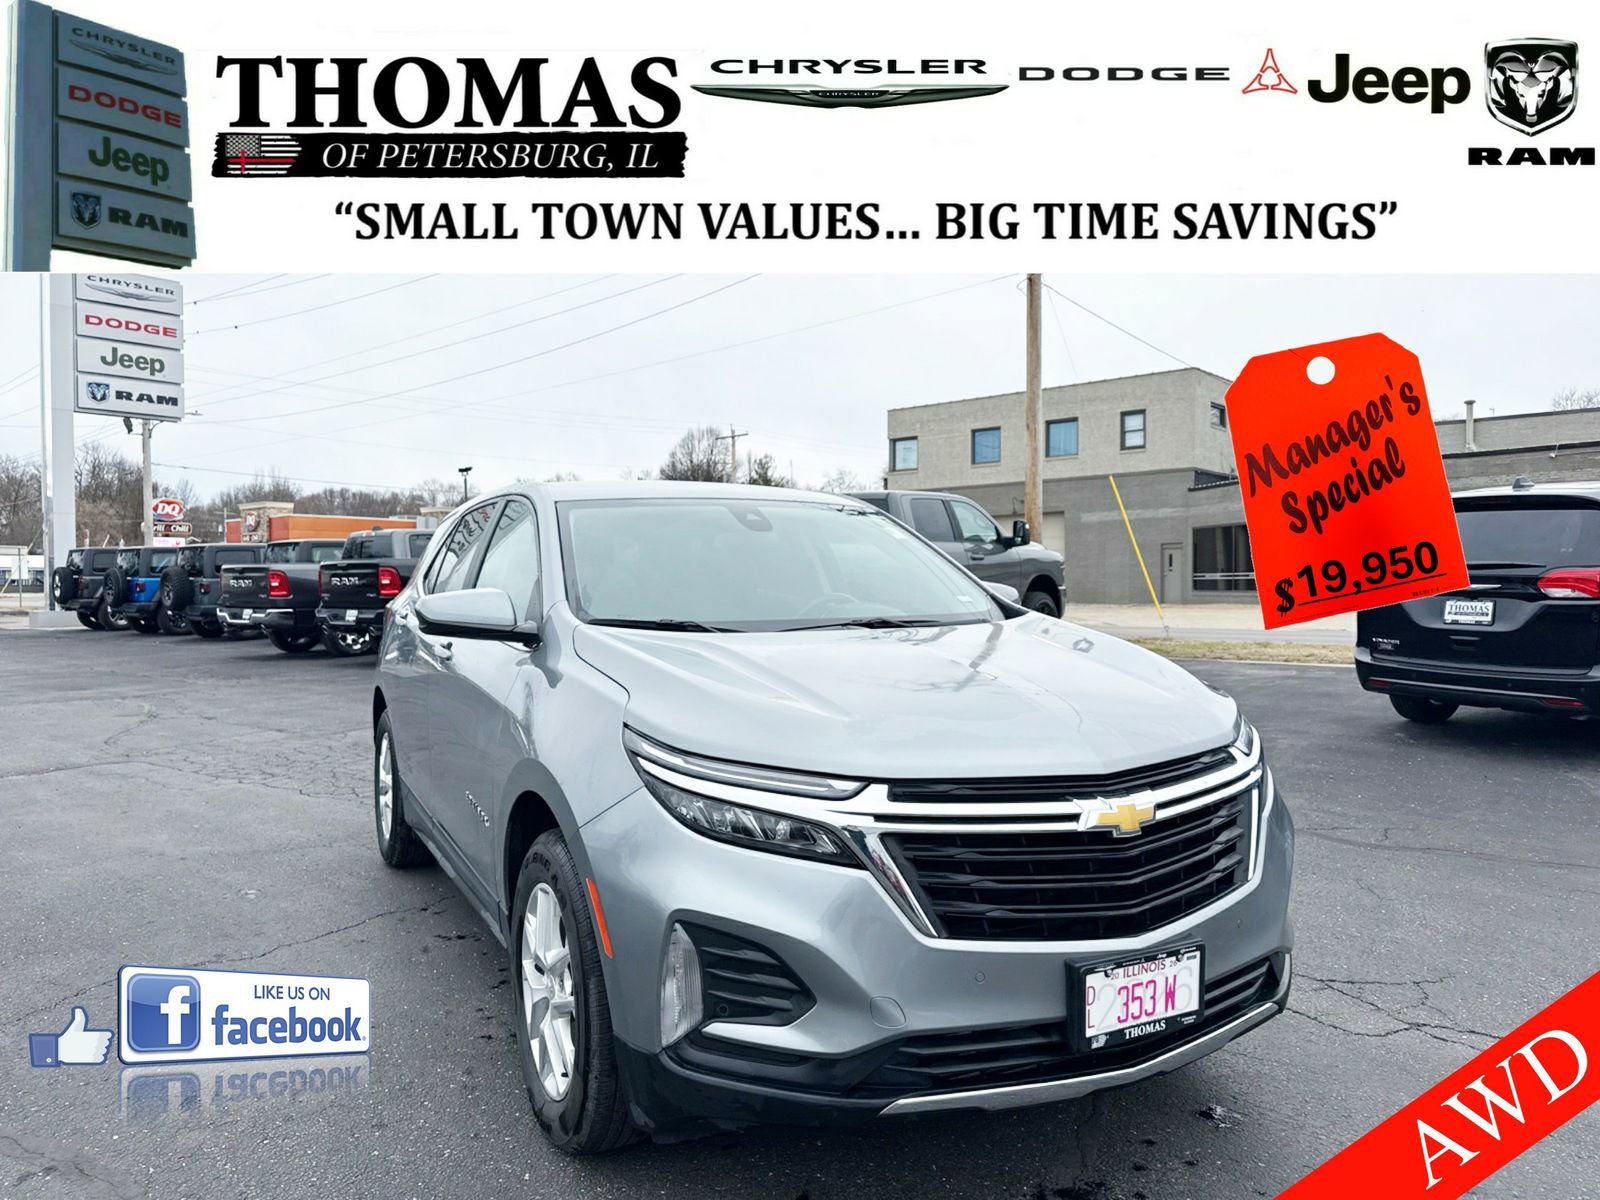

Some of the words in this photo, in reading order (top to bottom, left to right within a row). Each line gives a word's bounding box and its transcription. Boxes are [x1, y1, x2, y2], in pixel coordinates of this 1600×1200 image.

[87, 275, 175, 295] CHRYSLER
[85, 314, 178, 338] DODGE
[100, 347, 165, 376] Jeep
[115, 390, 178, 407] RAM
[157, 503, 180, 515] DQ
[229, 579, 253, 588] RAM
[331, 576, 359, 586] RAM
[1448, 603, 1490, 612] THOMAS
[1123, 959, 1166, 979] ILLINOIS
[1117, 979, 1157, 1024] 353
[1165, 974, 1177, 1013] W
[1124, 1020, 1166, 1040] THOMAS
